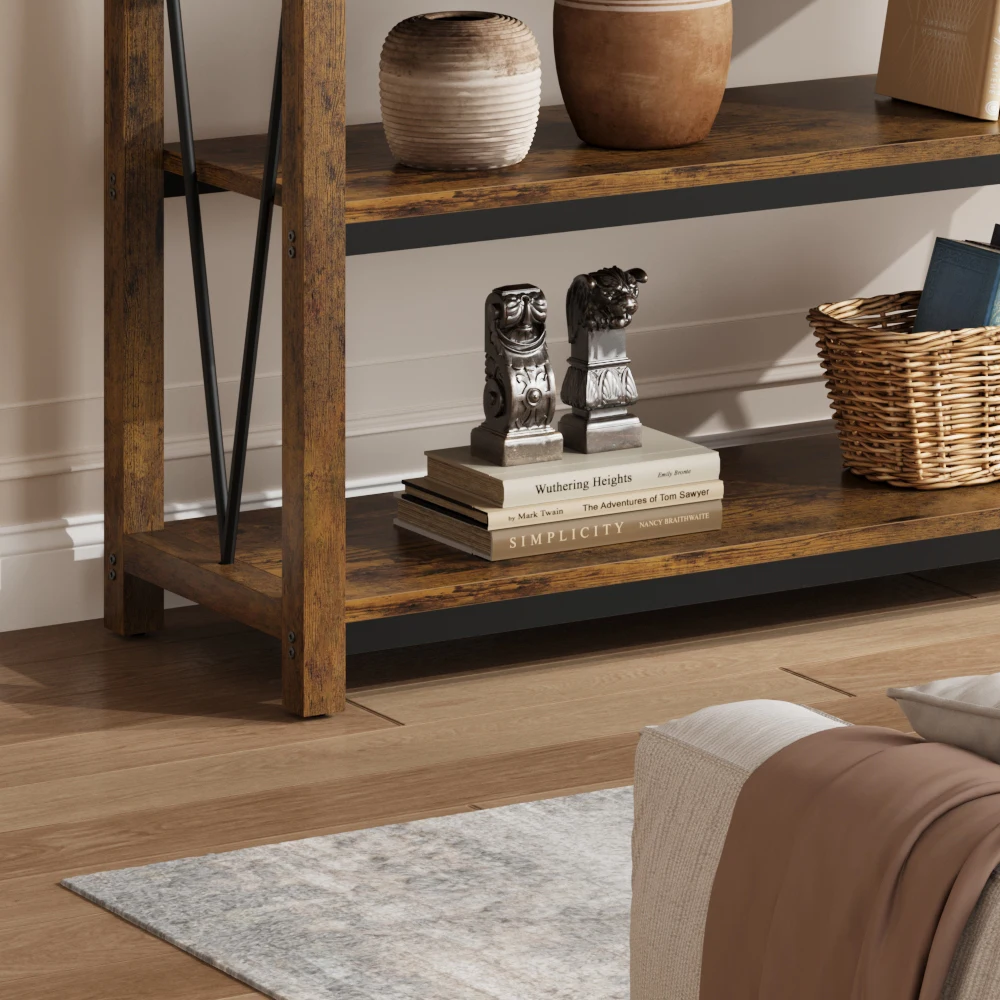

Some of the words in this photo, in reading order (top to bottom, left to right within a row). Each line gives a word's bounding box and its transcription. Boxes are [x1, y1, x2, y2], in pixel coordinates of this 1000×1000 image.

[535, 479, 589, 494] Wuthering
[593, 473, 633, 487] Heights
[583, 504, 598, 512] The
[600, 497, 647, 509] Adventures
[649, 494, 658, 503] of
[660, 493, 677, 502] Tom
[679, 489, 710, 499] Sawyer
[517, 511, 538, 520] Mark
[540, 507, 564, 517] Twain
[639, 519, 666, 529] NANCY
[664, 512, 710, 525] BRAITHWAITE
[509, 521, 624, 549] SIMPLICITY
